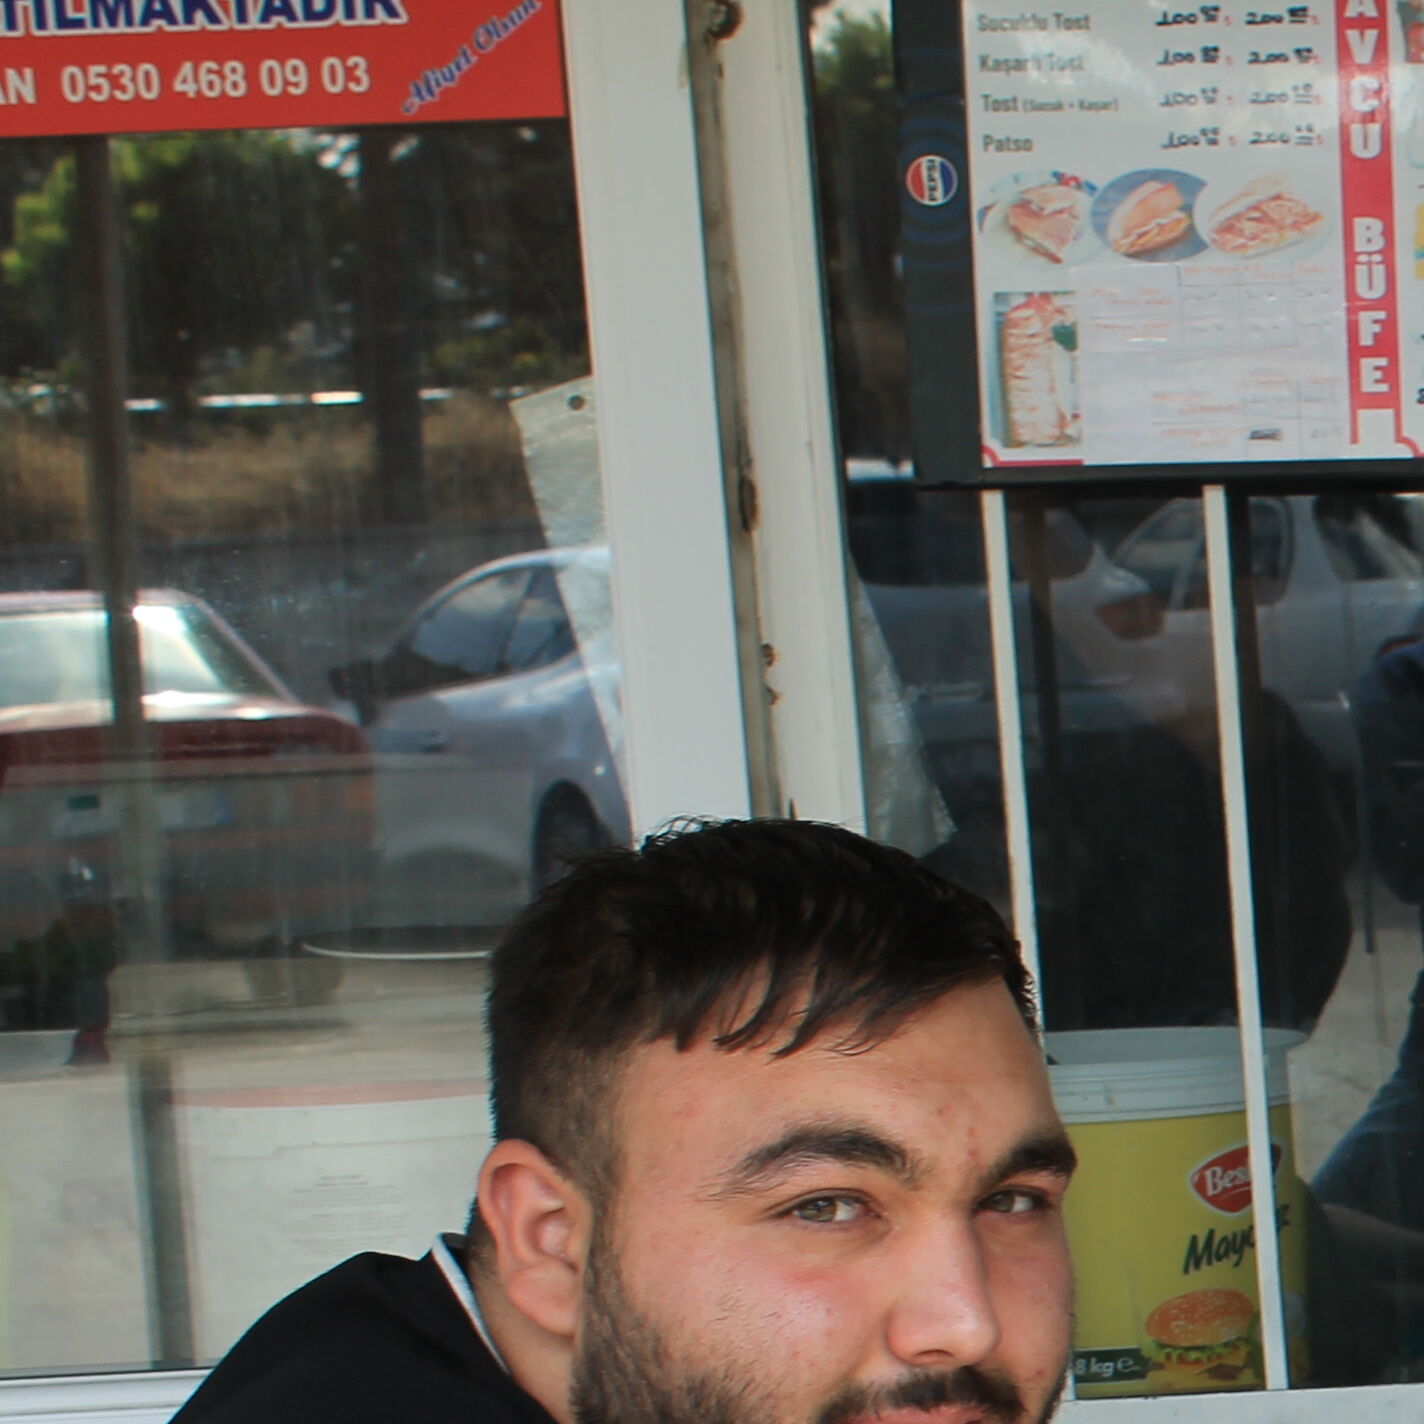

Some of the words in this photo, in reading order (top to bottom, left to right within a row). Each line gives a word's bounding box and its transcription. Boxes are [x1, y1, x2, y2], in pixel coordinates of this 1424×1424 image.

[0, 67, 37, 104] N
[61, 64, 160, 104] 0530
[173, 60, 247, 99] 468
[259, 58, 308, 96] 09
[320, 56, 370, 93] 03
[982, 135, 1034, 153] Patso
[926, 158, 939, 202] PEPSI
[1353, 217, 1390, 394] BÜFE
